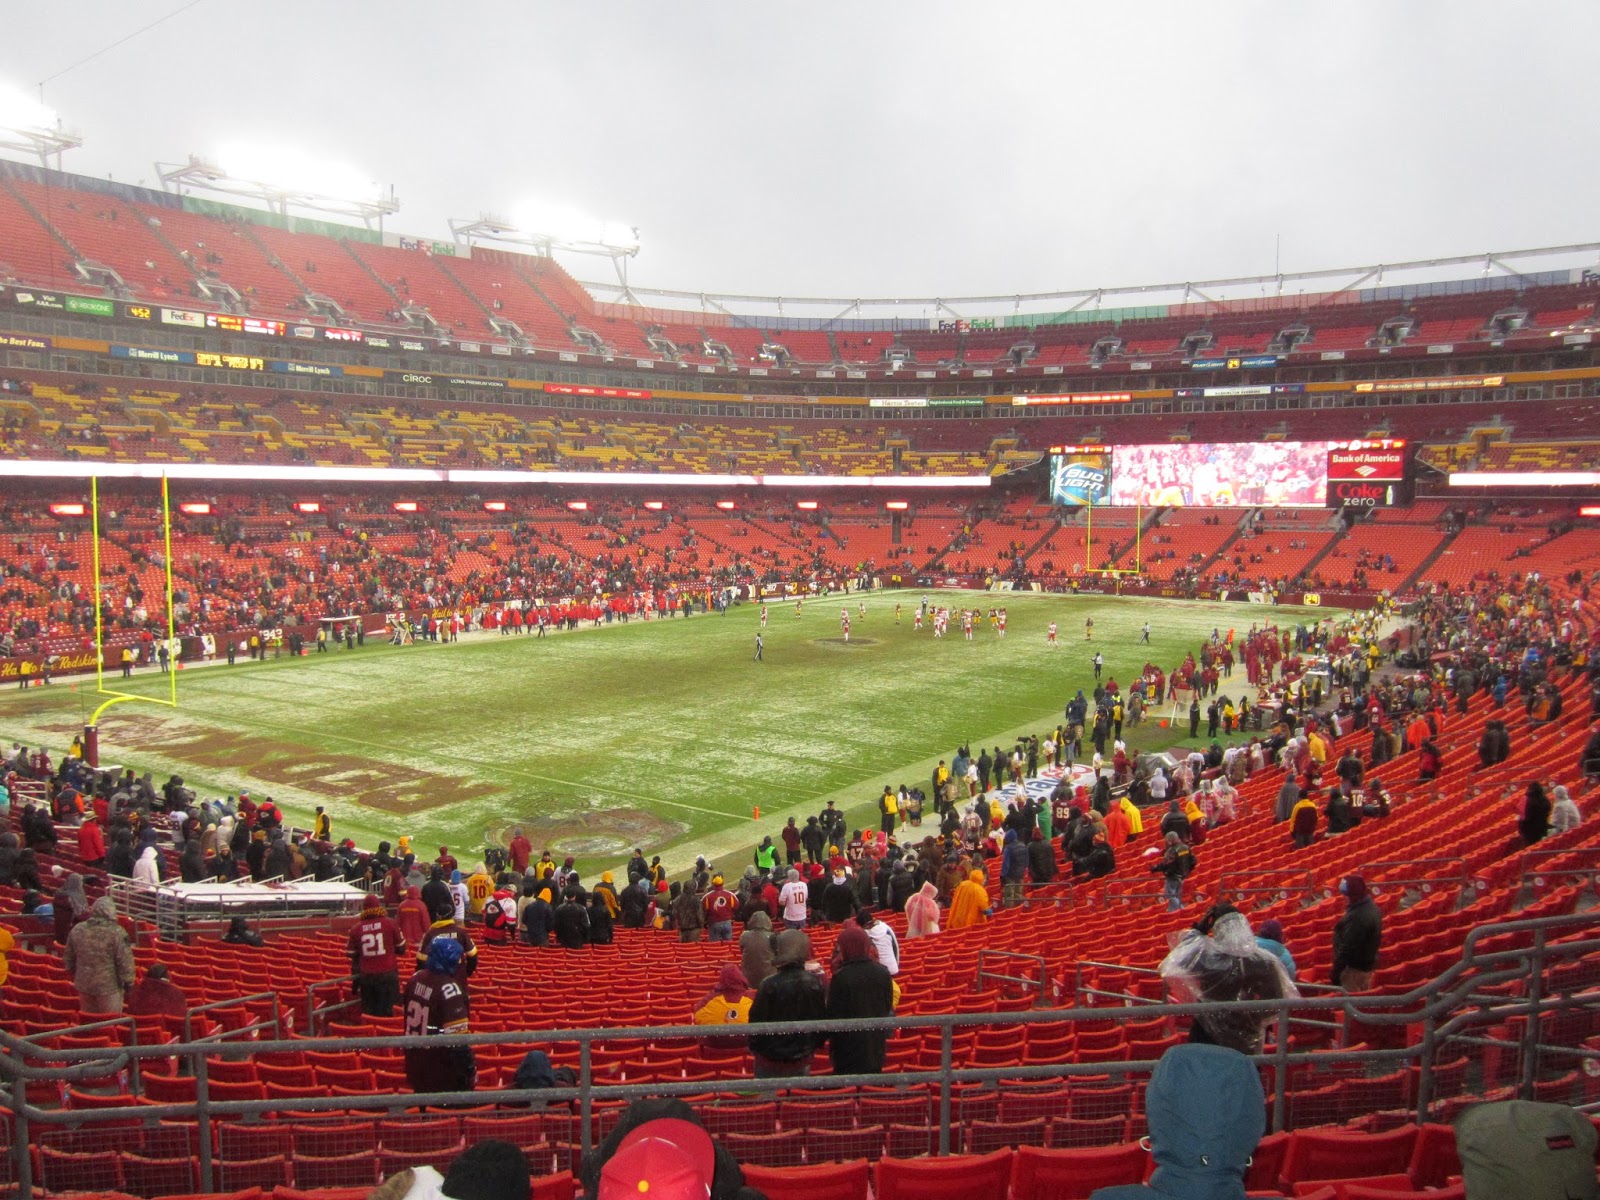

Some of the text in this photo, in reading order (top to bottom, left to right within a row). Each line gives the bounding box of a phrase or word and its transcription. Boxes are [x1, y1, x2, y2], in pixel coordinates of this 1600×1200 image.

[170, 310, 194, 321] FedEx
[9, 337, 26, 346] Best
[160, 351, 179, 361] Lynch
[1332, 453, 1400, 463] Bank of America
[1065, 468, 1105, 483] BUD
[1058, 478, 1105, 492] LIGHT
[1336, 482, 1385, 499] Coke
[1343, 497, 1376, 507] zero
[1352, 793, 1364, 807] 10
[473, 885, 486, 899] 10
[793, 891, 805, 905] 10
[361, 932, 387, 957] 21
[441, 982, 463, 1000] 21
[405, 1000, 431, 1036] 21
